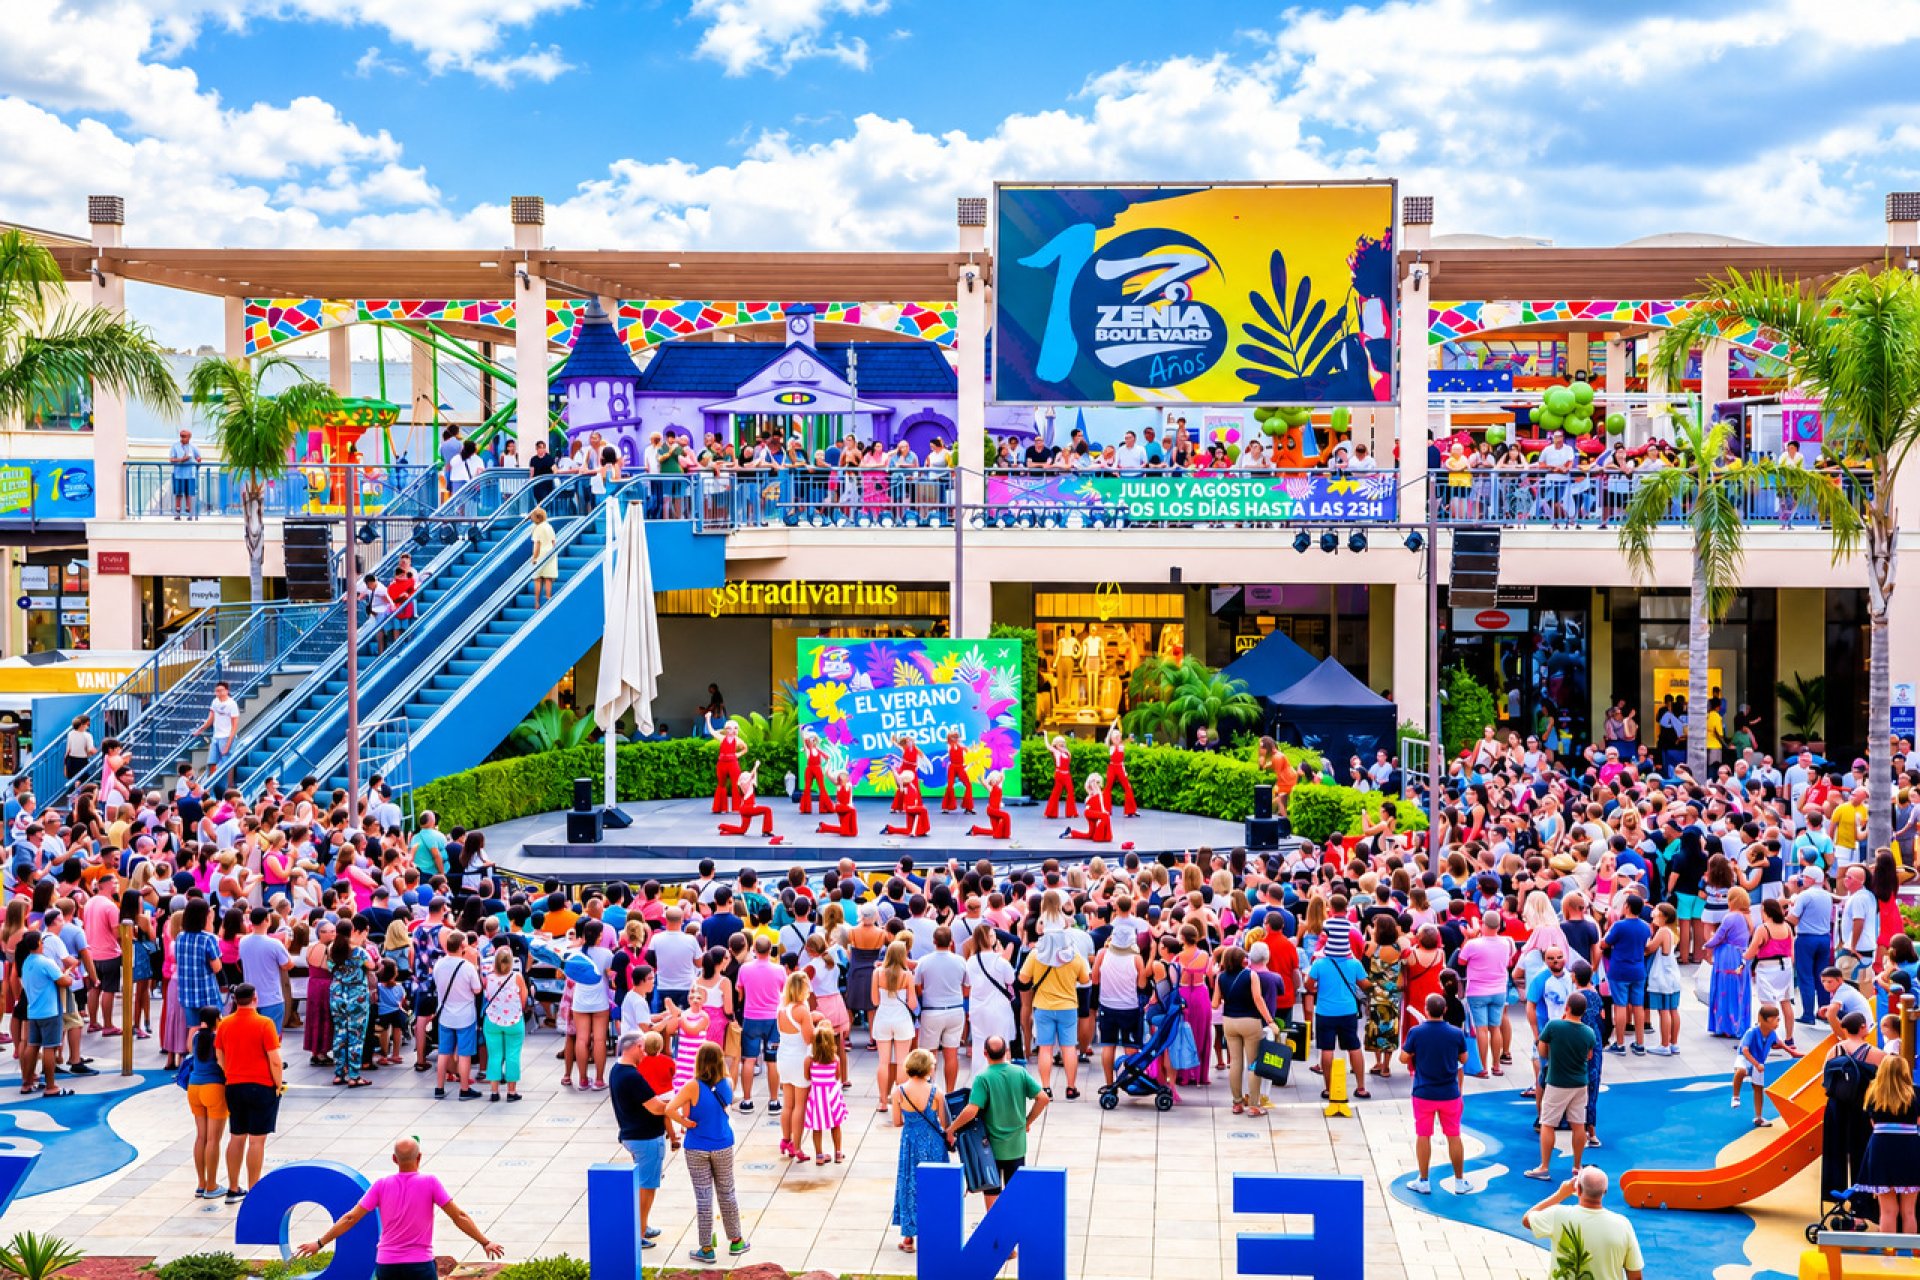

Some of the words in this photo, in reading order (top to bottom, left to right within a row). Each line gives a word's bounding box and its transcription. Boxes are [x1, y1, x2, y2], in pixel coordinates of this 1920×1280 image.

[1096, 305, 1210, 328] ZENIA
[1094, 328, 1213, 341] BOULEVARD
[1148, 352, 1205, 384] Años
[1119, 482, 1170, 498] JULIO
[1174, 482, 1187, 498] Y
[1189, 482, 1266, 498] AGOSTO
[1159, 502, 1194, 517] LOS
[1198, 498, 1240, 517] DÍAS
[1244, 502, 1305, 517] HASTA
[1310, 502, 1344, 517] LAS
[1347, 502, 1383, 517] 23H
[725, 579, 898, 605] stradivarius
[855, 695, 878, 714] EL
[879, 687, 961, 711] VERANO
[881, 711, 907, 730] DE
[911, 708, 936, 726] LA
